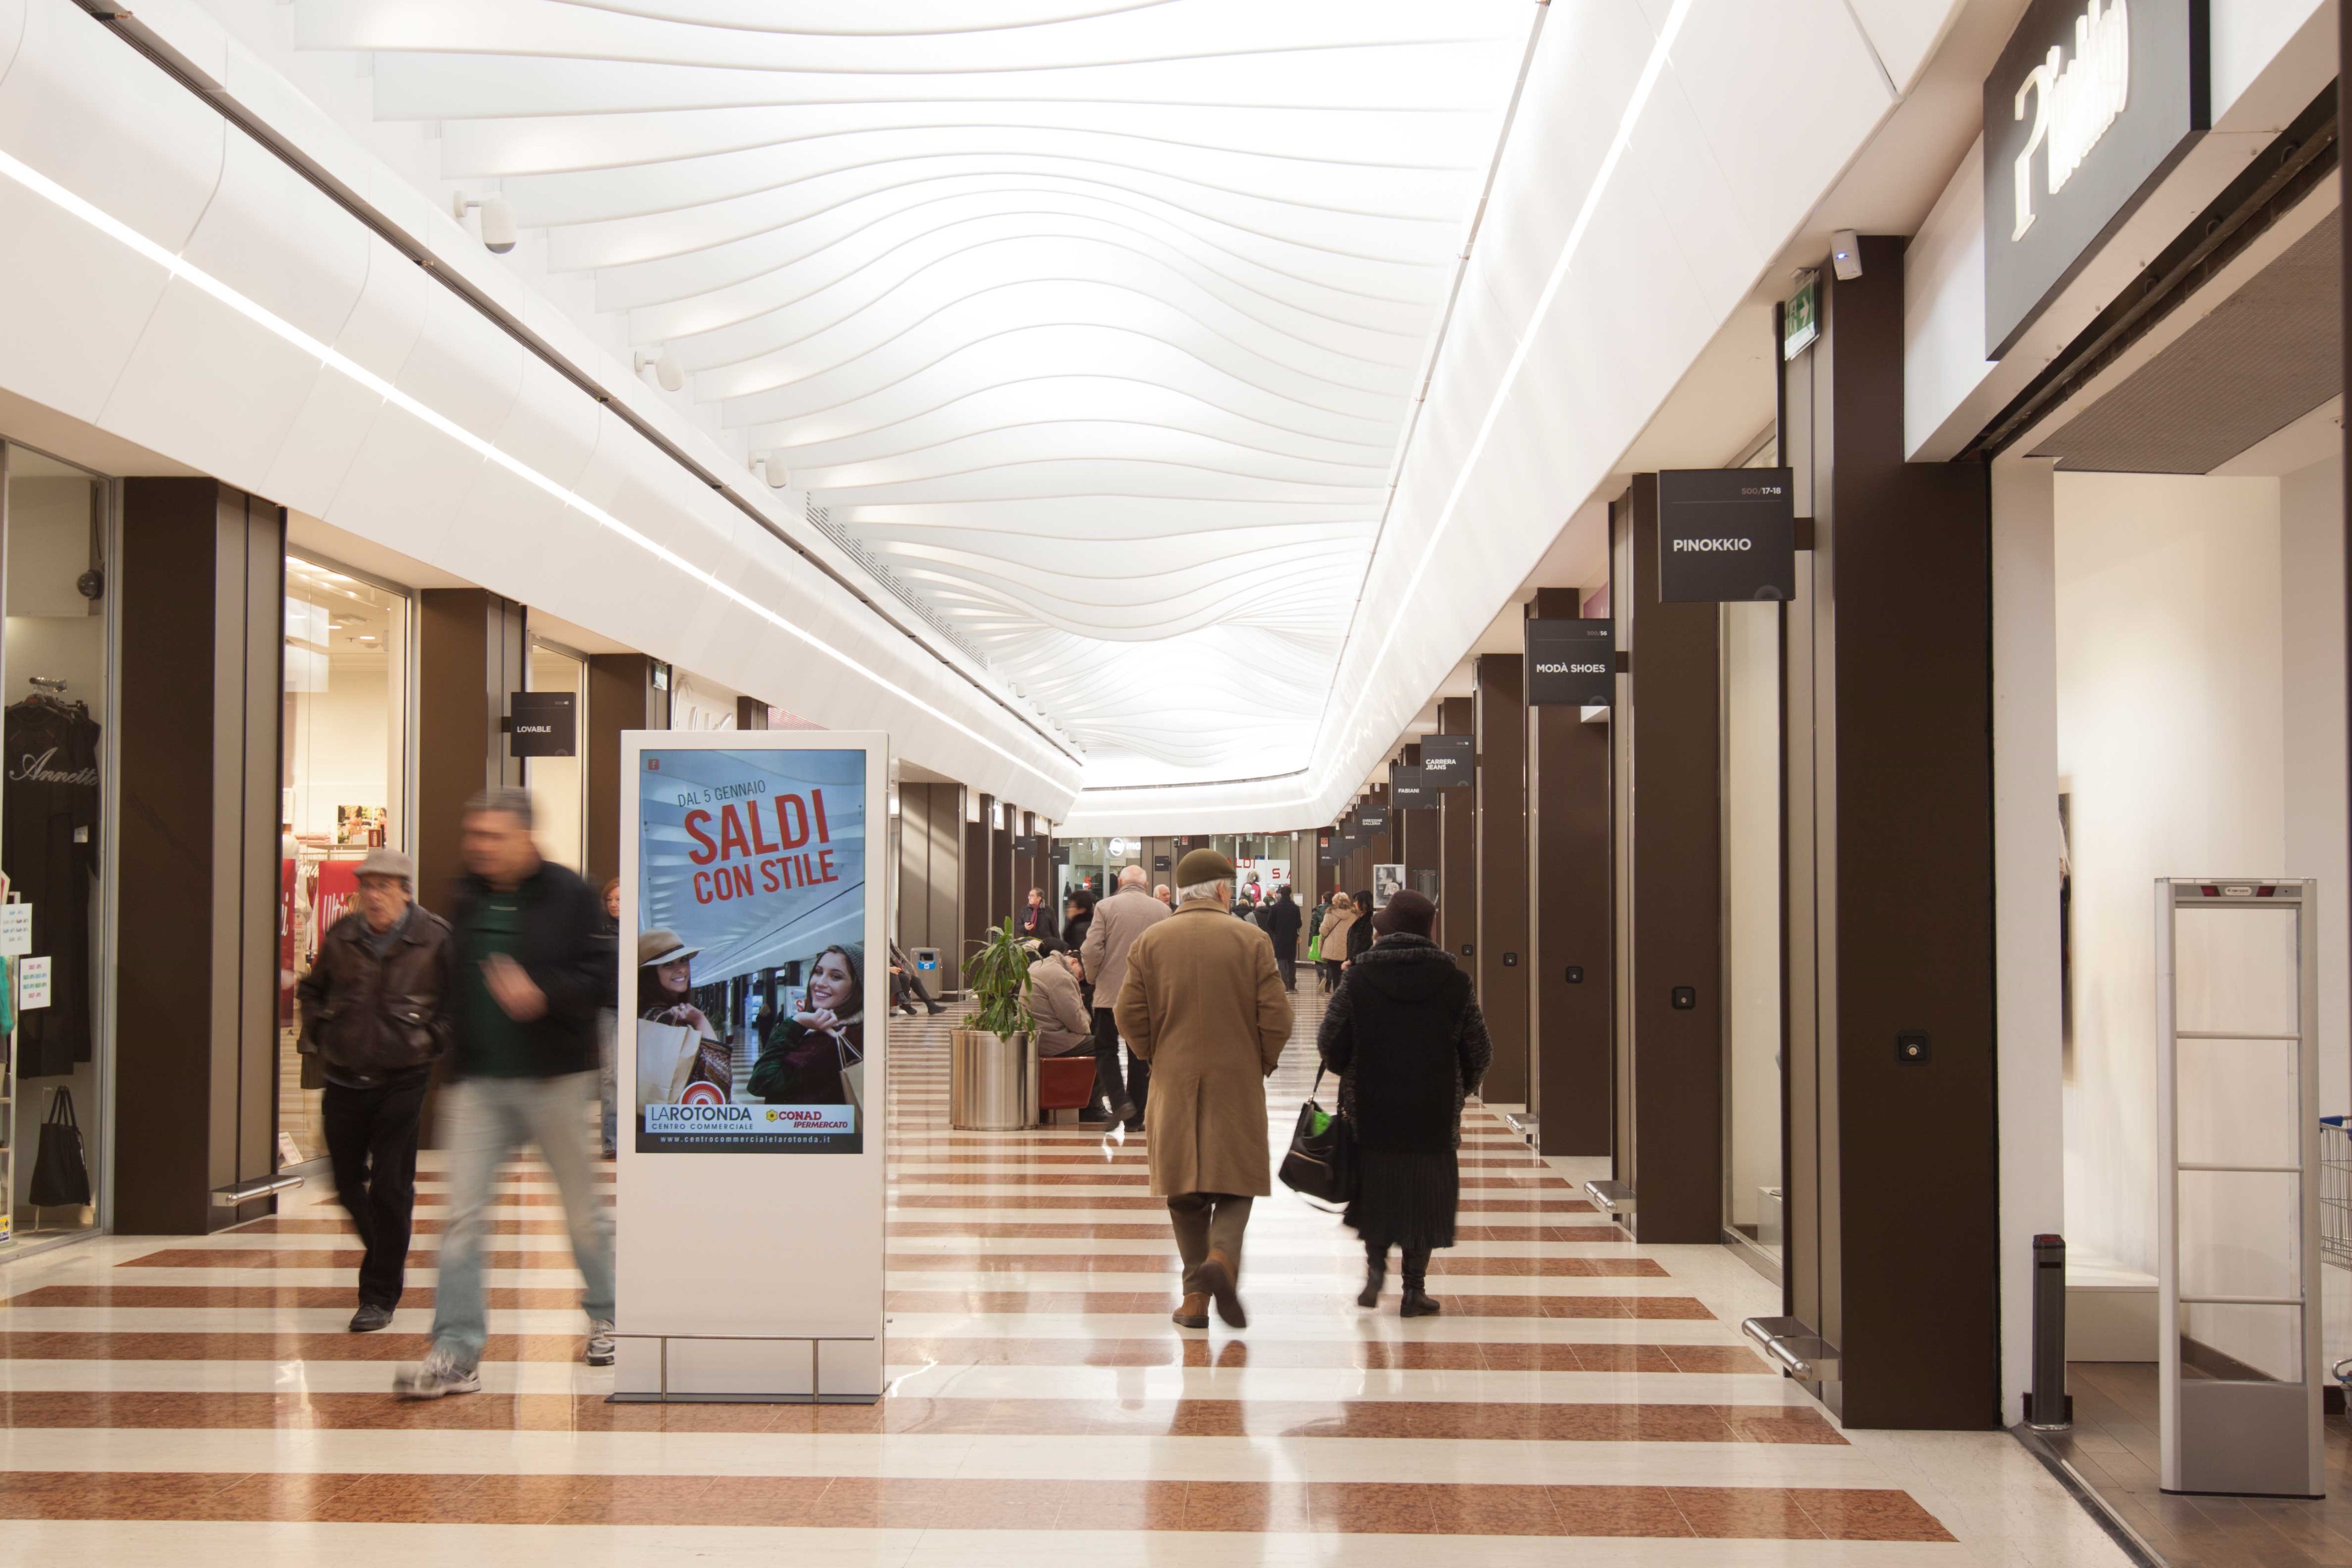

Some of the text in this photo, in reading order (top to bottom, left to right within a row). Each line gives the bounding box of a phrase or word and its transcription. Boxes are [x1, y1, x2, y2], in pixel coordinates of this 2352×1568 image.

[1741, 487, 1781, 495] 500/17-18
[1673, 538, 1751, 552] PINOKKIO
[1536, 662, 1606, 673] MODÀ SHOES
[9, 747, 99, 786] Annette
[678, 780, 766, 807] DAL 5 GENNAIO
[684, 788, 830, 865] SALDI
[694, 849, 838, 904] CON STILE
[651, 1106, 822, 1121] LAROTONDA CONAD
[660, 1135, 831, 1143] www.centrocommercialelarotonda.it
